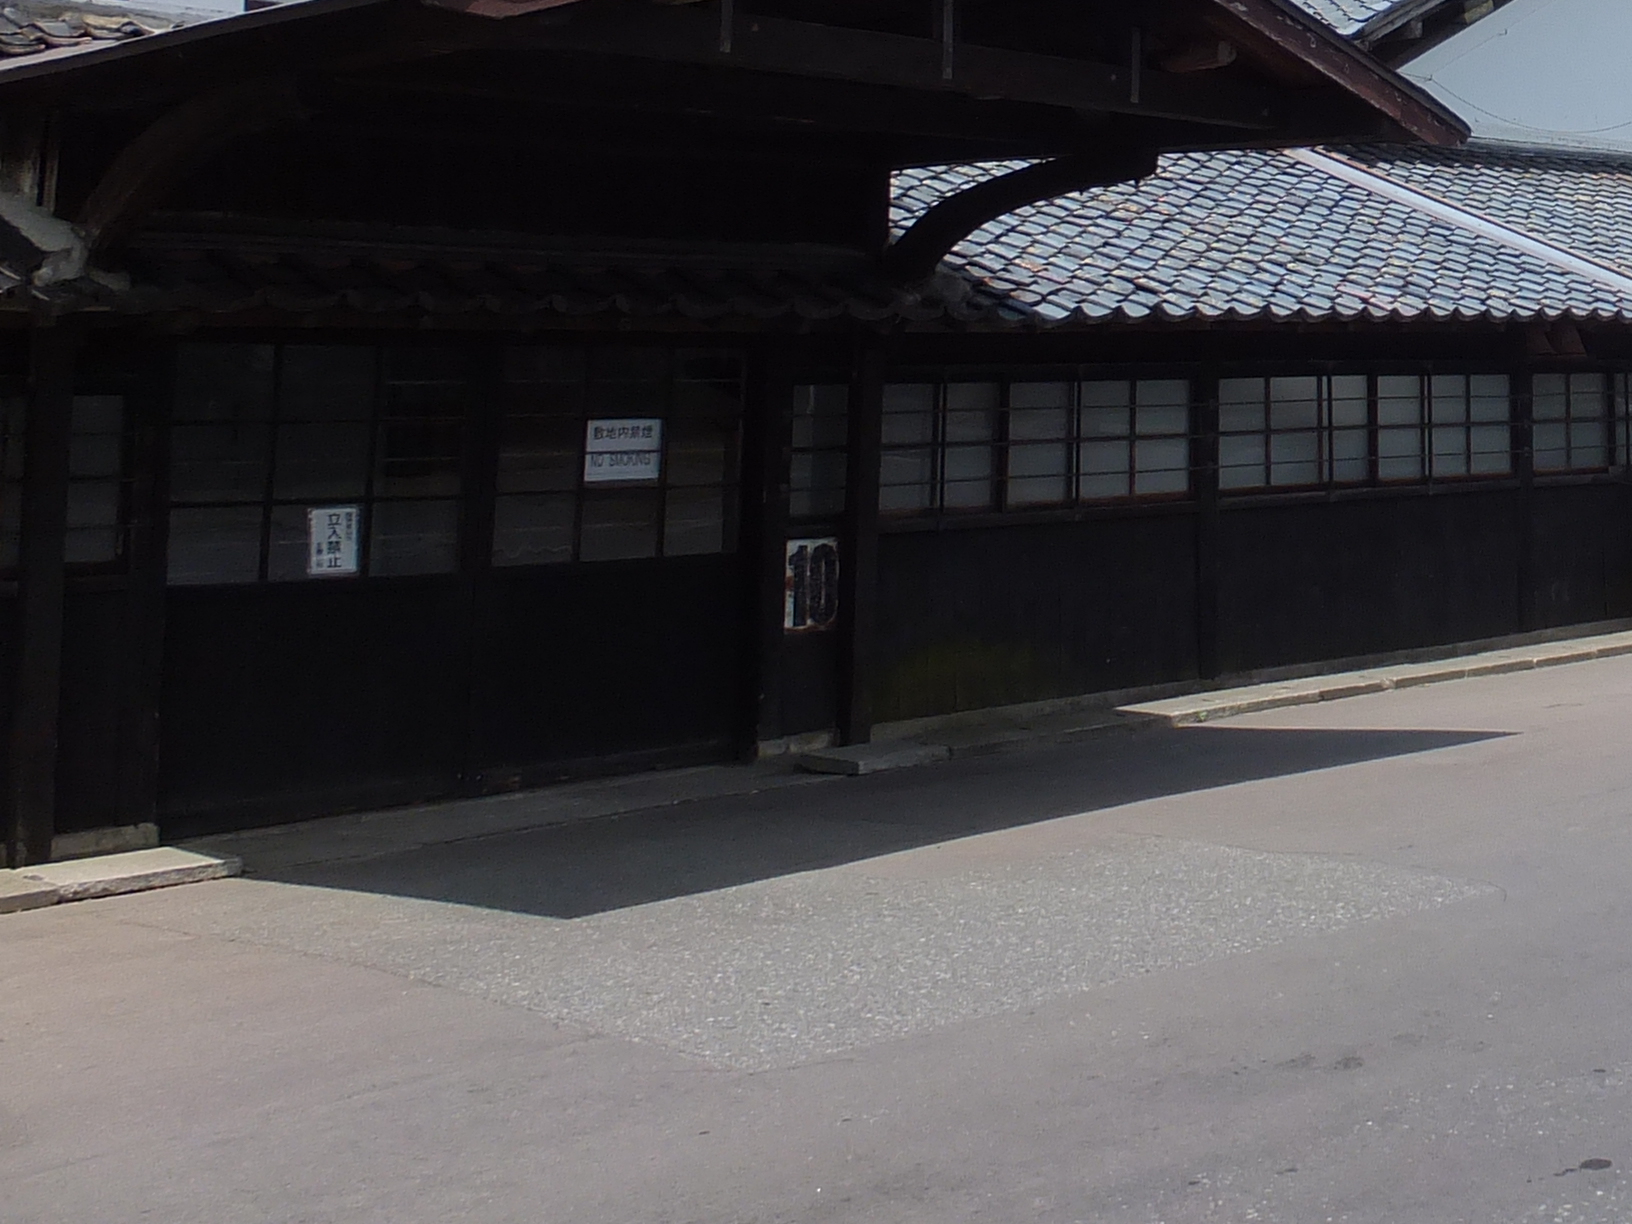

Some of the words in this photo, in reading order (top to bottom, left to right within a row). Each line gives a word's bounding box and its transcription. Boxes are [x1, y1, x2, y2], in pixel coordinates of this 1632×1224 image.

[590, 453, 604, 468] NO
[609, 452, 651, 467] SMOKING
[327, 512, 342, 568] 立入禁止
[788, 543, 839, 626] 10
